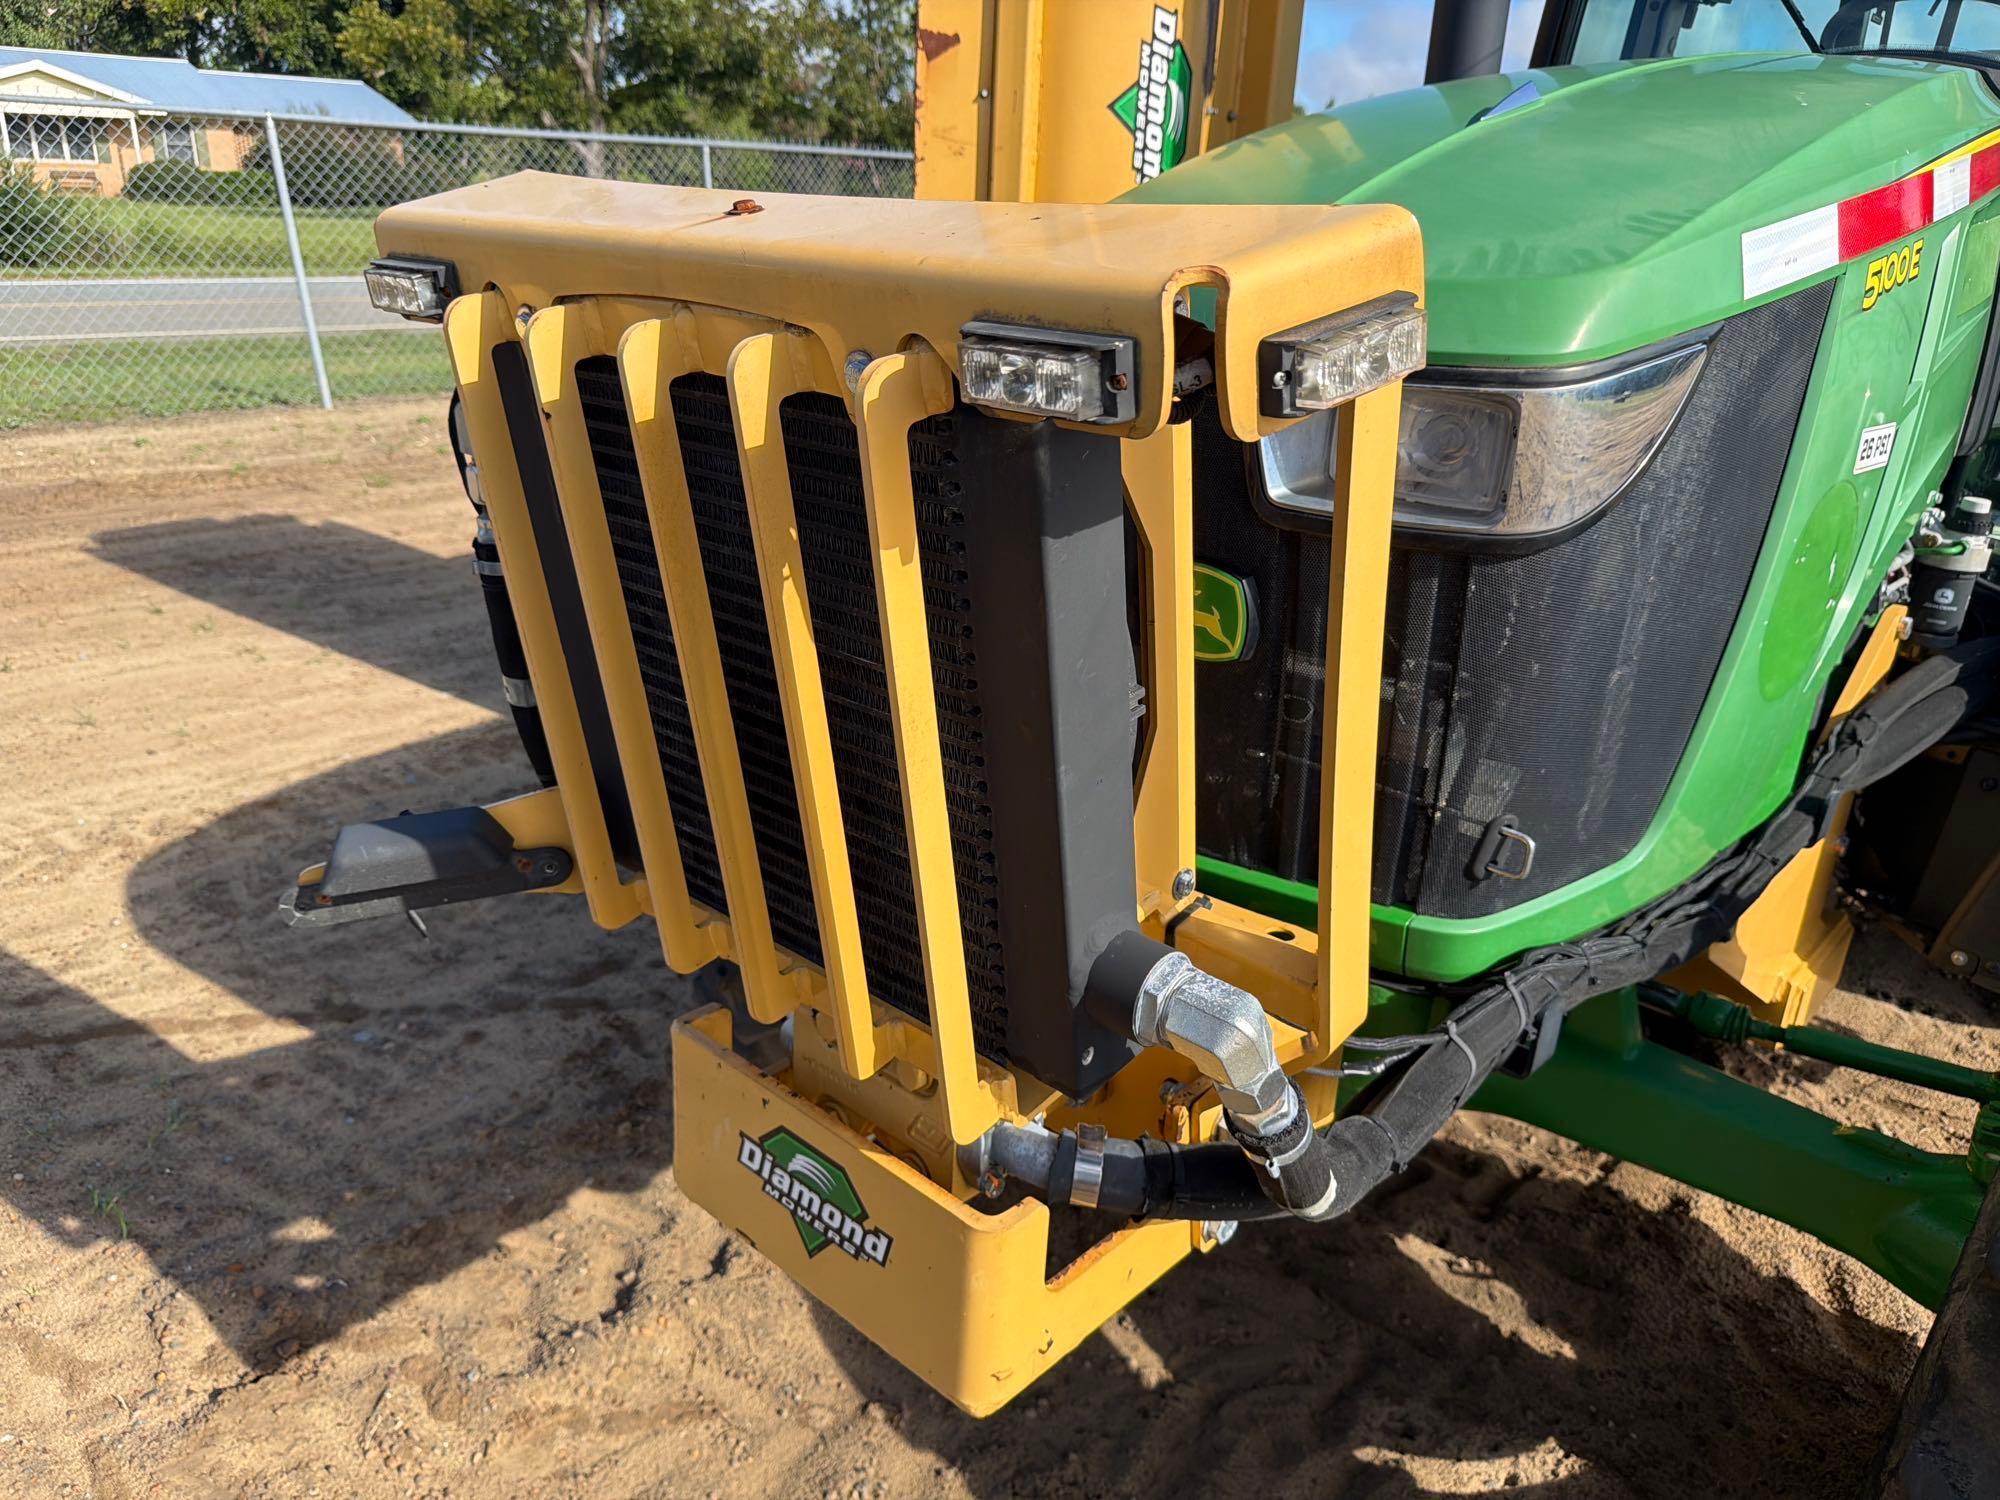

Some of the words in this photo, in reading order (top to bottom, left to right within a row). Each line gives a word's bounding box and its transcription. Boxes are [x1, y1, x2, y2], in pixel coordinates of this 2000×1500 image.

[1133, 43, 1150, 169] MOWERS
[1862, 237, 1924, 311] 5100E
[1860, 437, 1875, 461] 26
[1873, 433, 1892, 458] PSI
[739, 1136, 889, 1263] Diamond
[764, 1184, 858, 1256] MOWERS
